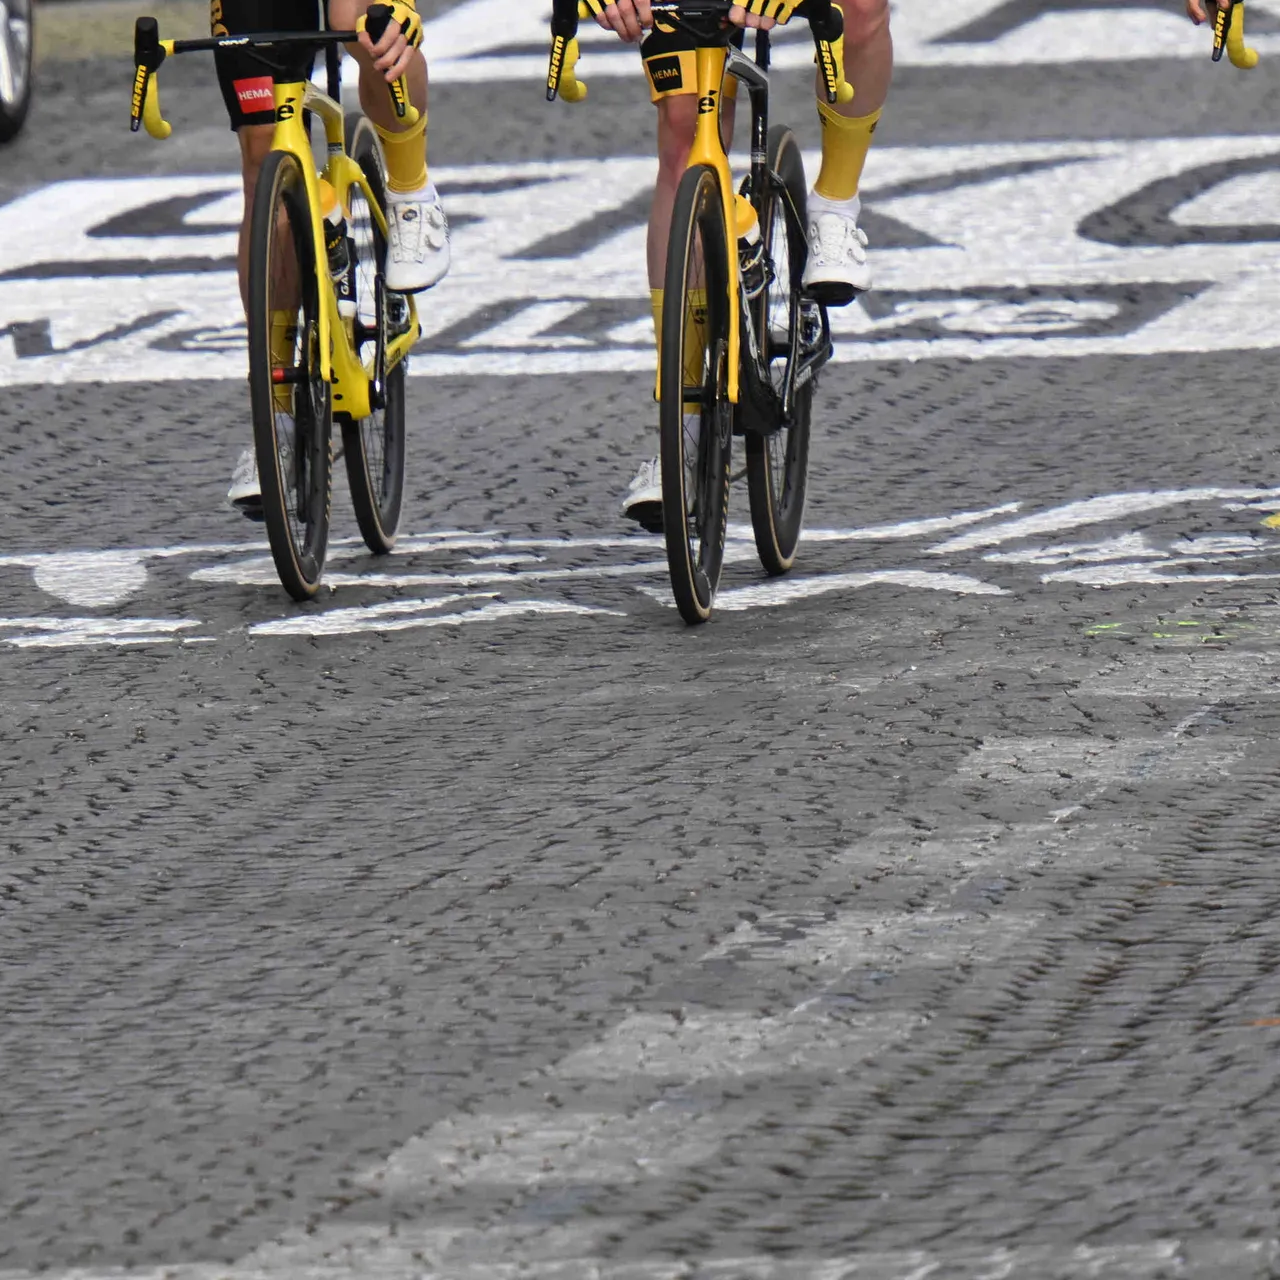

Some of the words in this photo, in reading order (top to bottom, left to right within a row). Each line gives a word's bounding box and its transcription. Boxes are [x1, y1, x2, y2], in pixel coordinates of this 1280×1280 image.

[547, 35, 564, 91] SRAM
[651, 67, 680, 81] HEMA
[820, 39, 836, 94] SRAM
[131, 65, 147, 120] SRAM
[238, 88, 273, 102] HEMA
